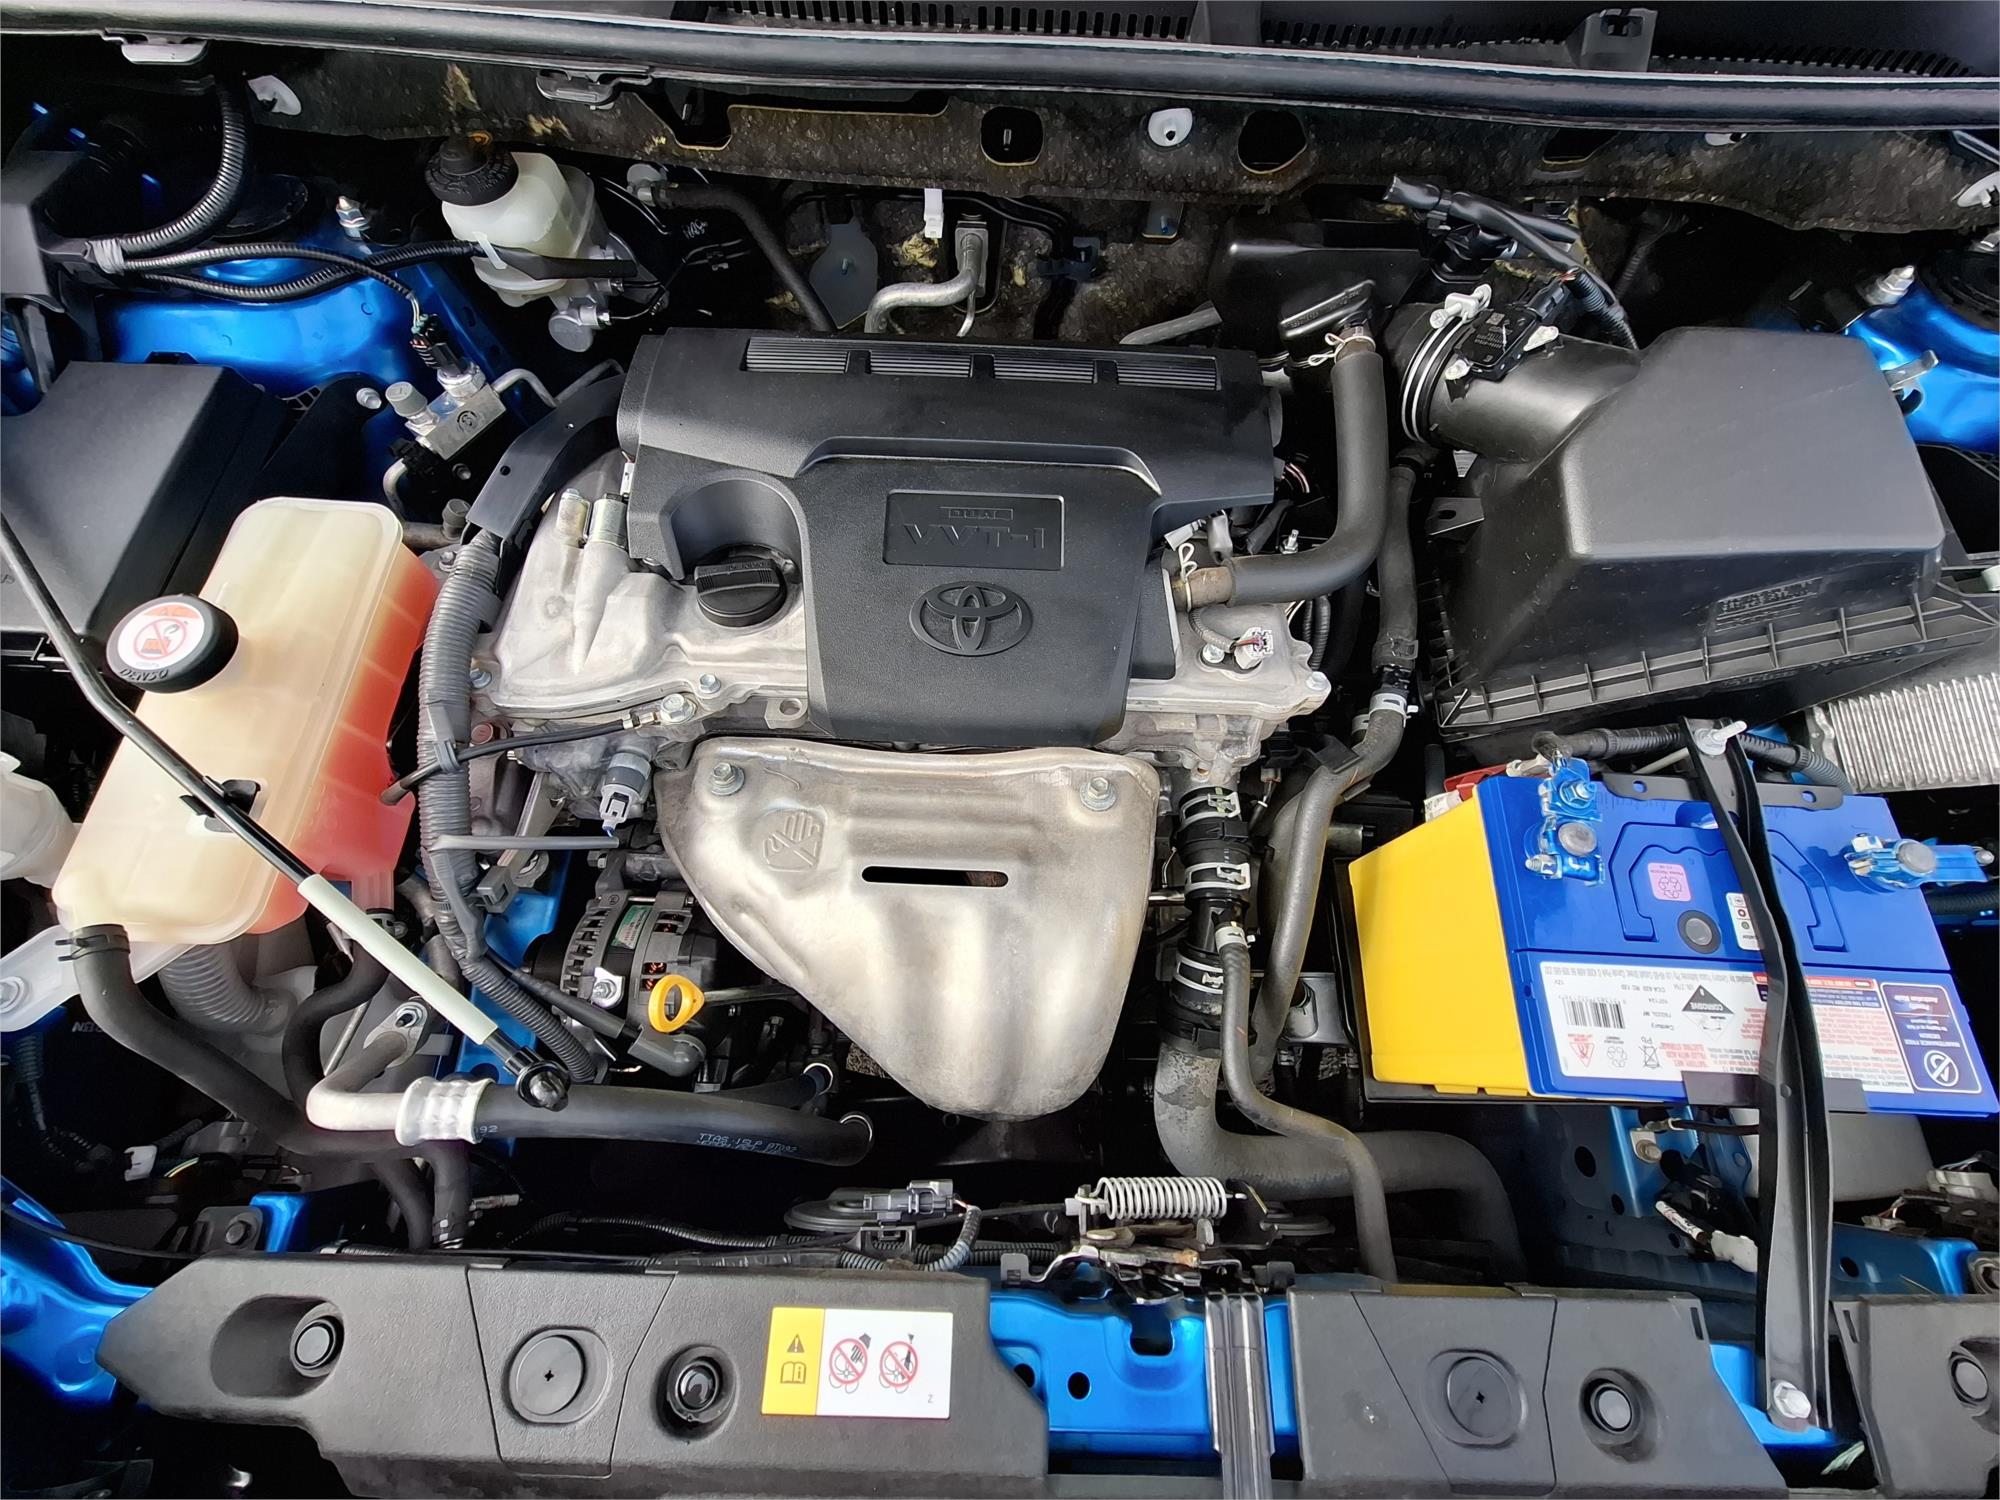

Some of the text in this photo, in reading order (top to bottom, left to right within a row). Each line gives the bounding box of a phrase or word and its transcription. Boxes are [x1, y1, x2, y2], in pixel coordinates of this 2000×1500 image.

[120, 667, 169, 682] DENSO
[1690, 1002, 1723, 1012] CORROSIVE
[1640, 1036, 1652, 1044] Pb
